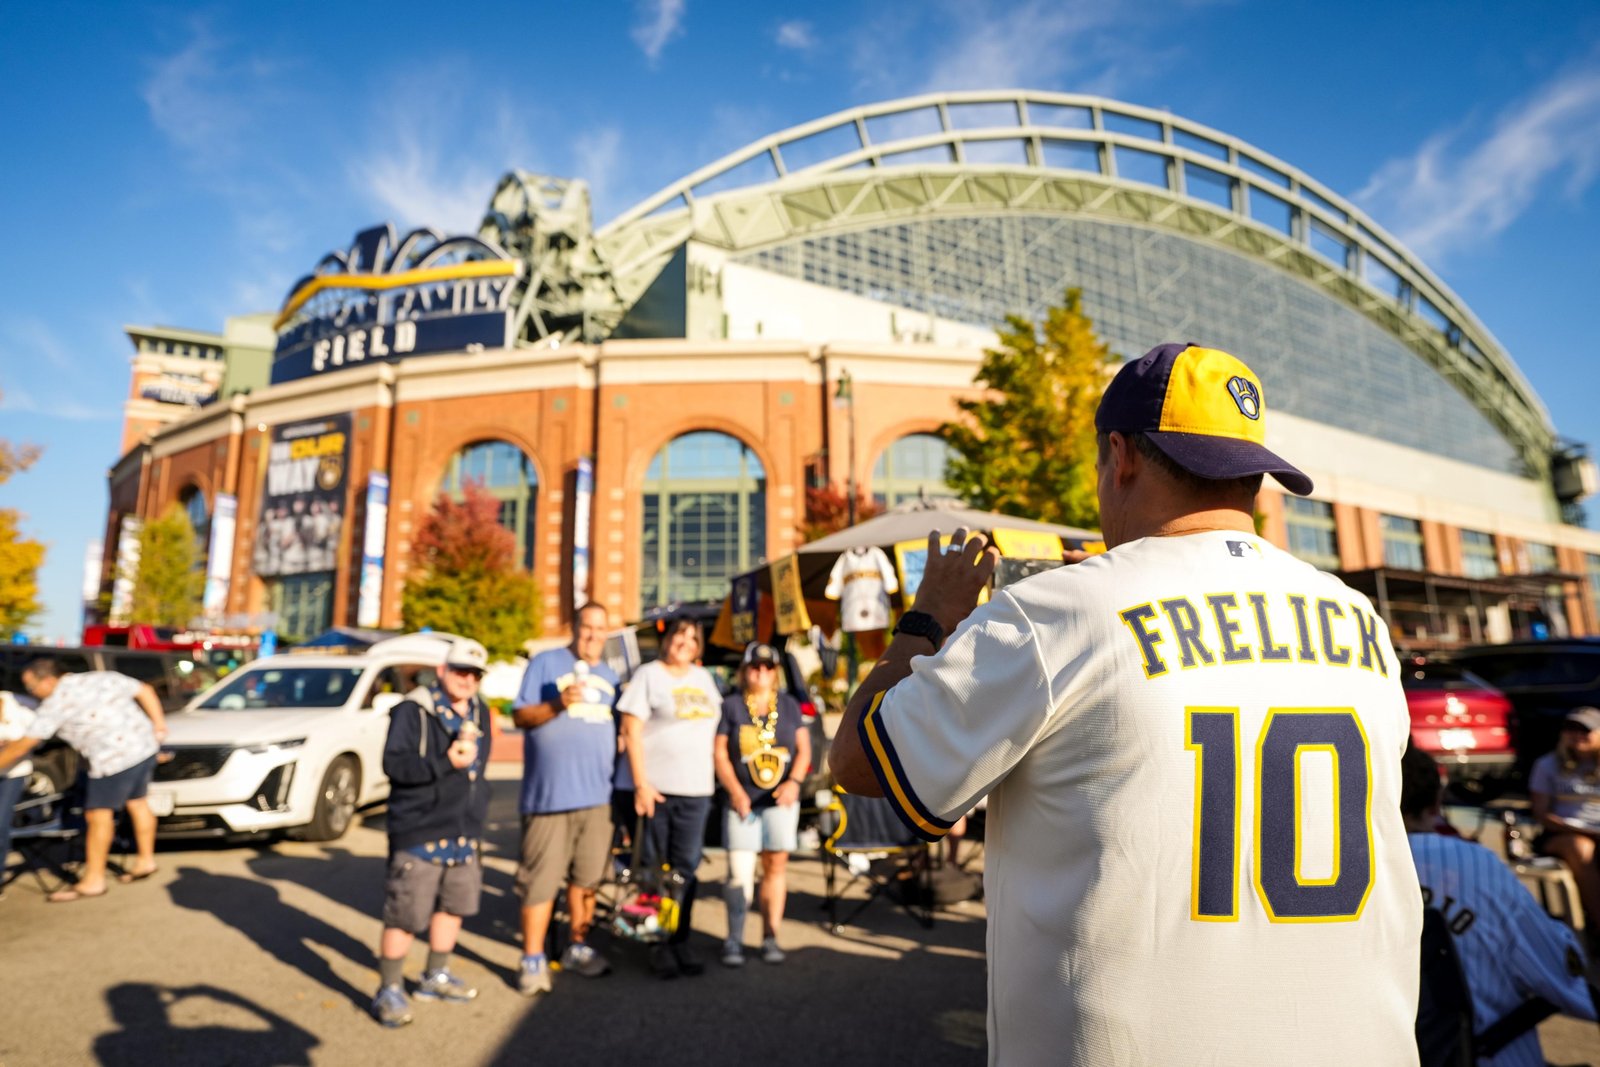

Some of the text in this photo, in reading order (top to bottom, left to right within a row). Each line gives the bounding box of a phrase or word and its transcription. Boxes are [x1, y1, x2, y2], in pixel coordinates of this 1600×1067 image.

[312, 319, 417, 371] FIELD
[268, 457, 319, 496] WAY
[1118, 591, 1389, 680] FRELICK
[1184, 706, 1376, 924] 10
